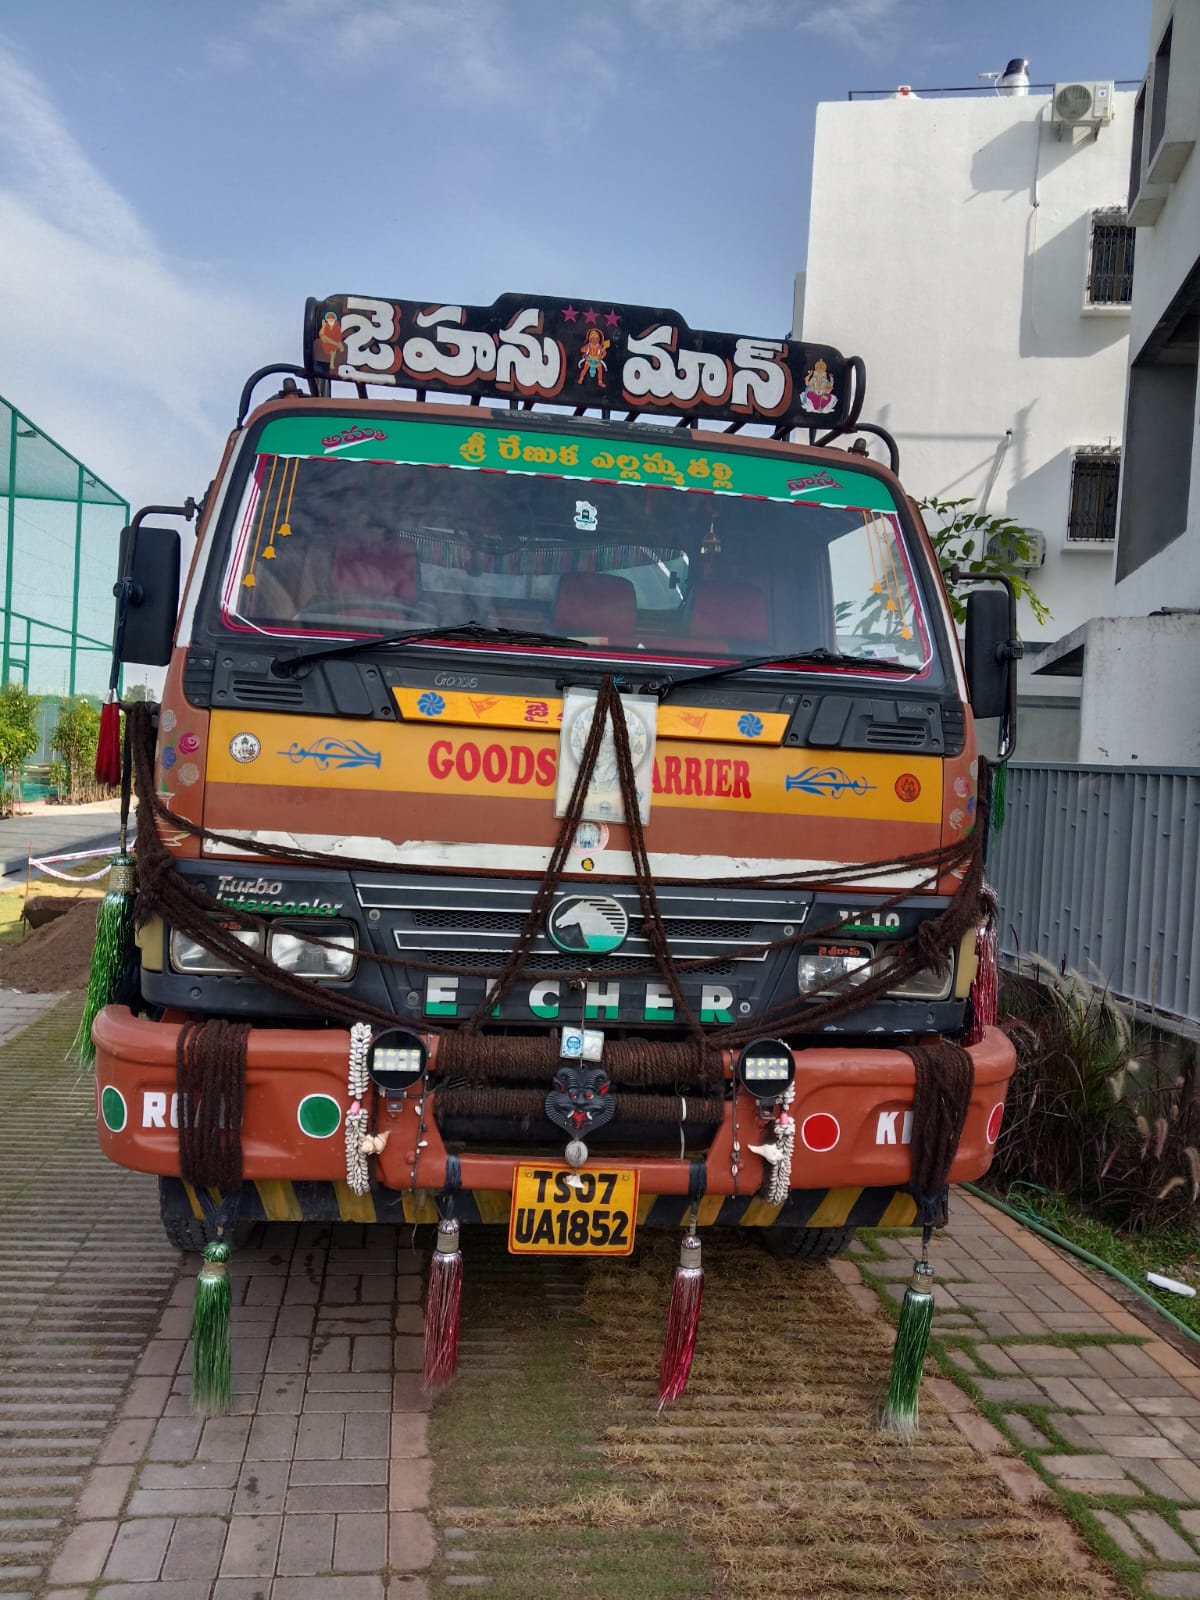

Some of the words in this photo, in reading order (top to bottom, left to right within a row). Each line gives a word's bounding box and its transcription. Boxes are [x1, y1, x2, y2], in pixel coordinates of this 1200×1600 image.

[459, 432, 487, 463] శ్రీ
[428, 740, 557, 788] GOODS
[651, 755, 752, 799] ARRIER
[218, 875, 283, 895] Turbo
[533, 1170, 618, 1205] TS07
[514, 1208, 629, 1246] UA1852
